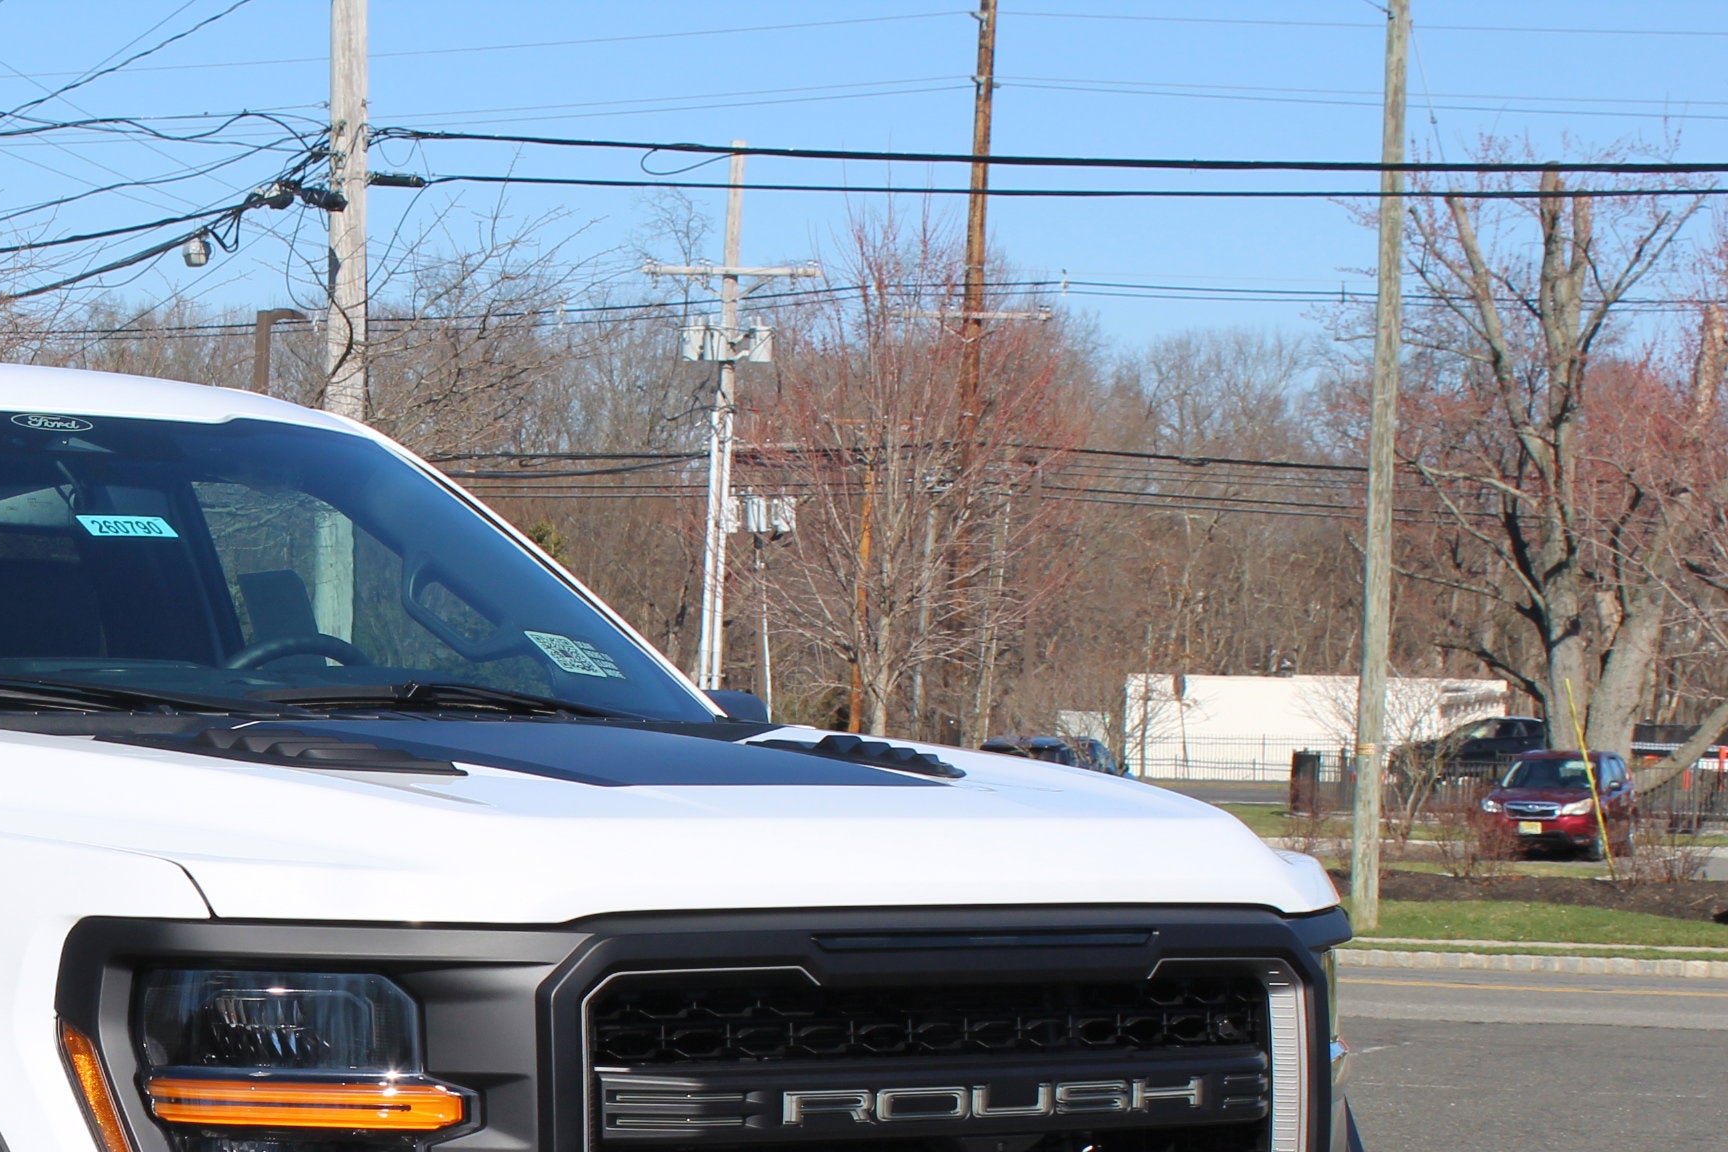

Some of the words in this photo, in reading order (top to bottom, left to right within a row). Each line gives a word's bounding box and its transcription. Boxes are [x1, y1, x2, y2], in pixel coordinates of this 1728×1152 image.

[27, 415, 80, 429] Ford
[90, 520, 164, 534] 260790
[782, 1076, 1204, 1128] ROUSH
